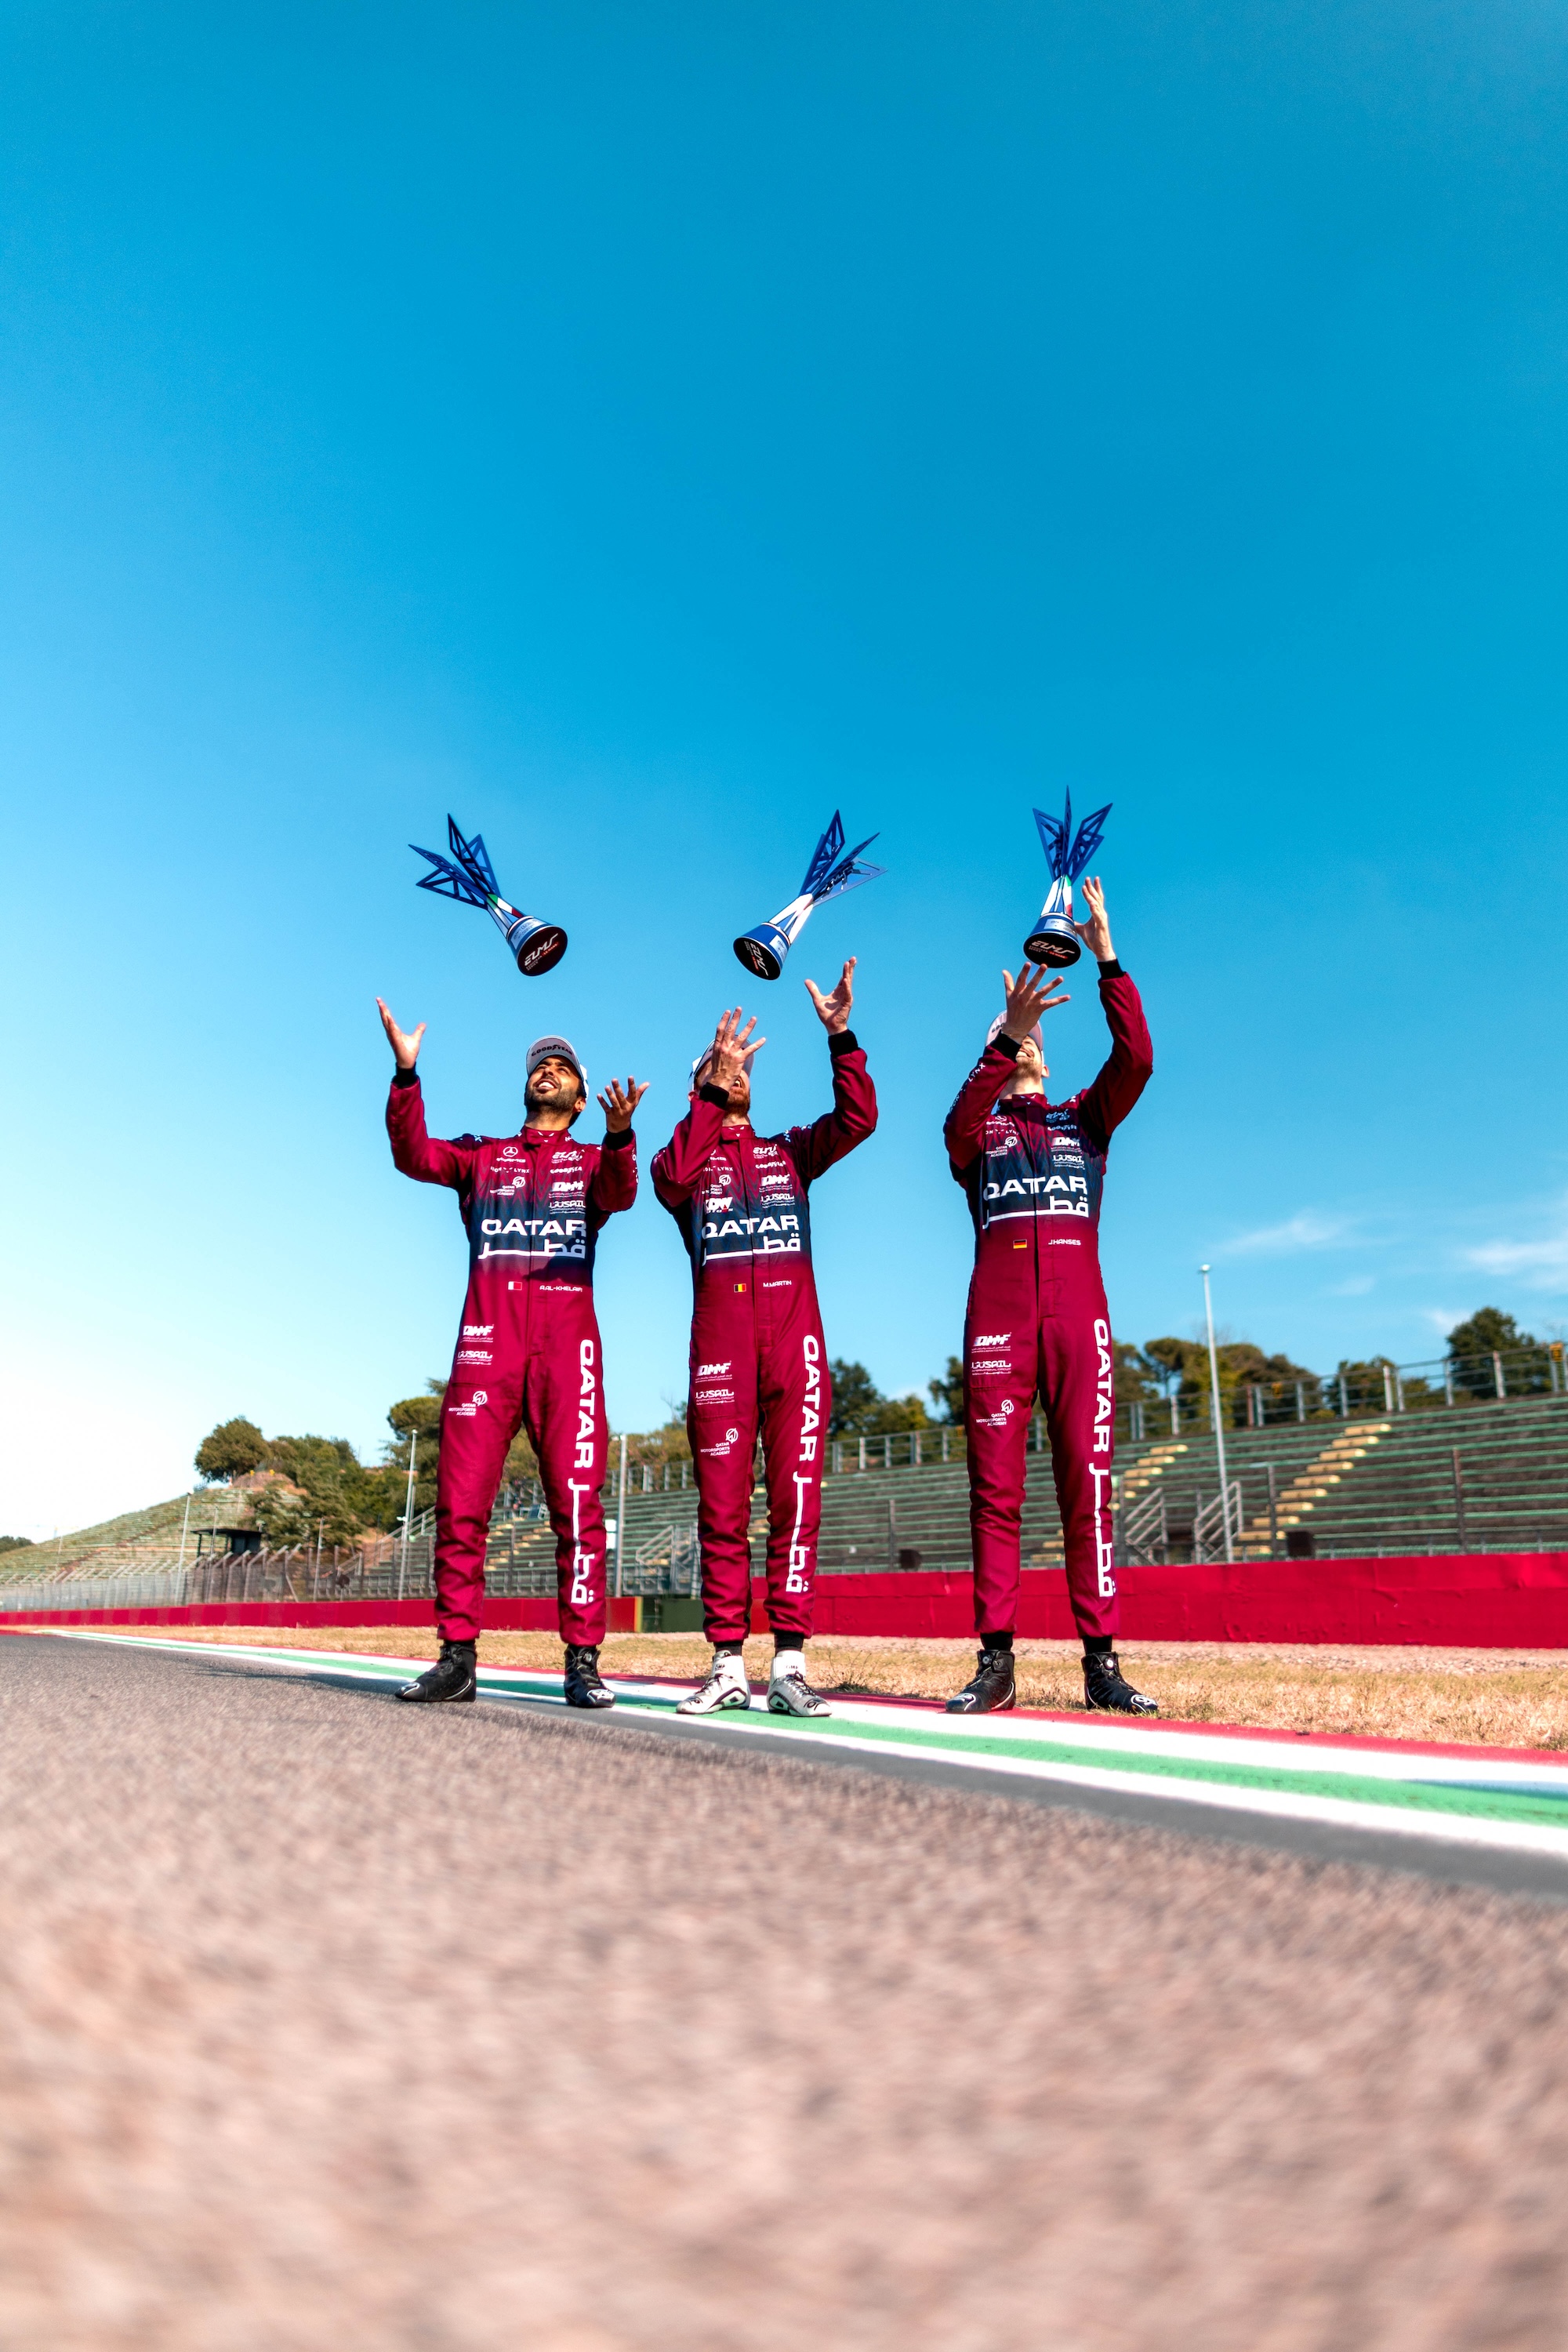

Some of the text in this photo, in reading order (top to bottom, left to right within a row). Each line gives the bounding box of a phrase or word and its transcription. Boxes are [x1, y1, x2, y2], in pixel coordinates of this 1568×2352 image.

[532, 1044, 572, 1056] GOODYEAR
[982, 1196, 1089, 1229] قطر
[983, 1175, 1087, 1200] QATAR
[477, 1239, 586, 1259] قطر
[481, 1218, 586, 1237] QATAR
[702, 1214, 799, 1240] QATAR
[574, 1339, 596, 1468] QATAR
[799, 1334, 821, 1462] QATAR
[1094, 1319, 1112, 1453] QATAR
[567, 1478, 595, 1605] قطر
[786, 1471, 813, 1593] قطر
[1088, 1462, 1116, 1598] قطر
